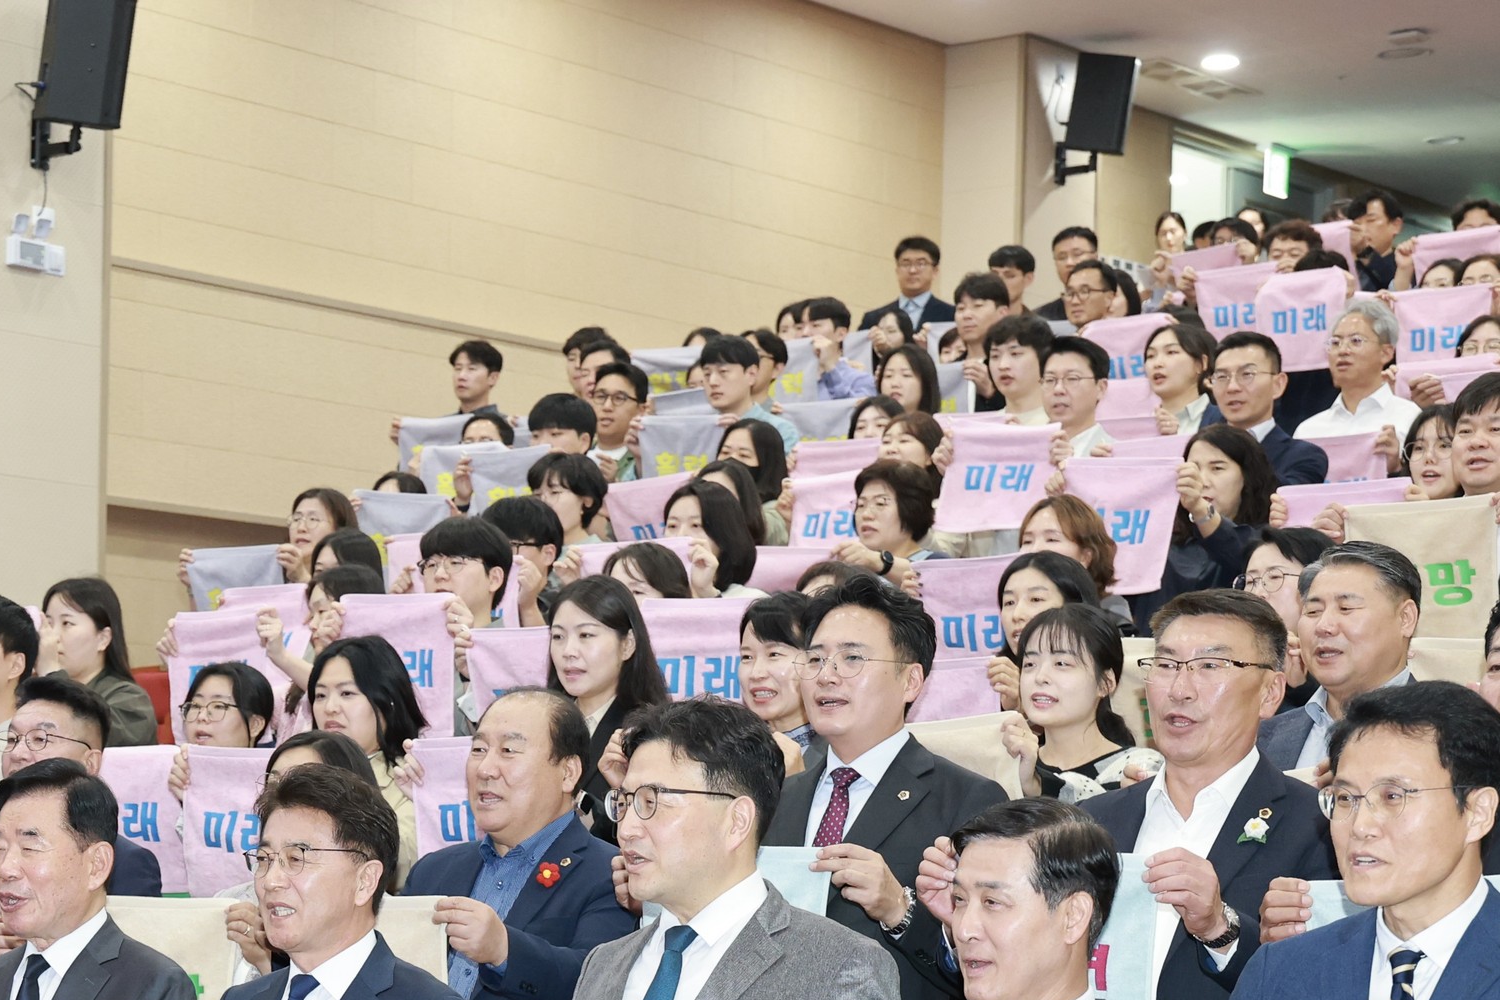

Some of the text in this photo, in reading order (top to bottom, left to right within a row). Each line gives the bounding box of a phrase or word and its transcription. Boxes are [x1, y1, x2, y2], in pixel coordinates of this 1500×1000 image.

[1271, 303, 1328, 336] 미래
[964, 463, 1035, 494] 미래
[1423, 558, 1477, 607] 망
[403, 648, 434, 688] 래
[122, 801, 161, 843] 래
[439, 802, 477, 843] 미
